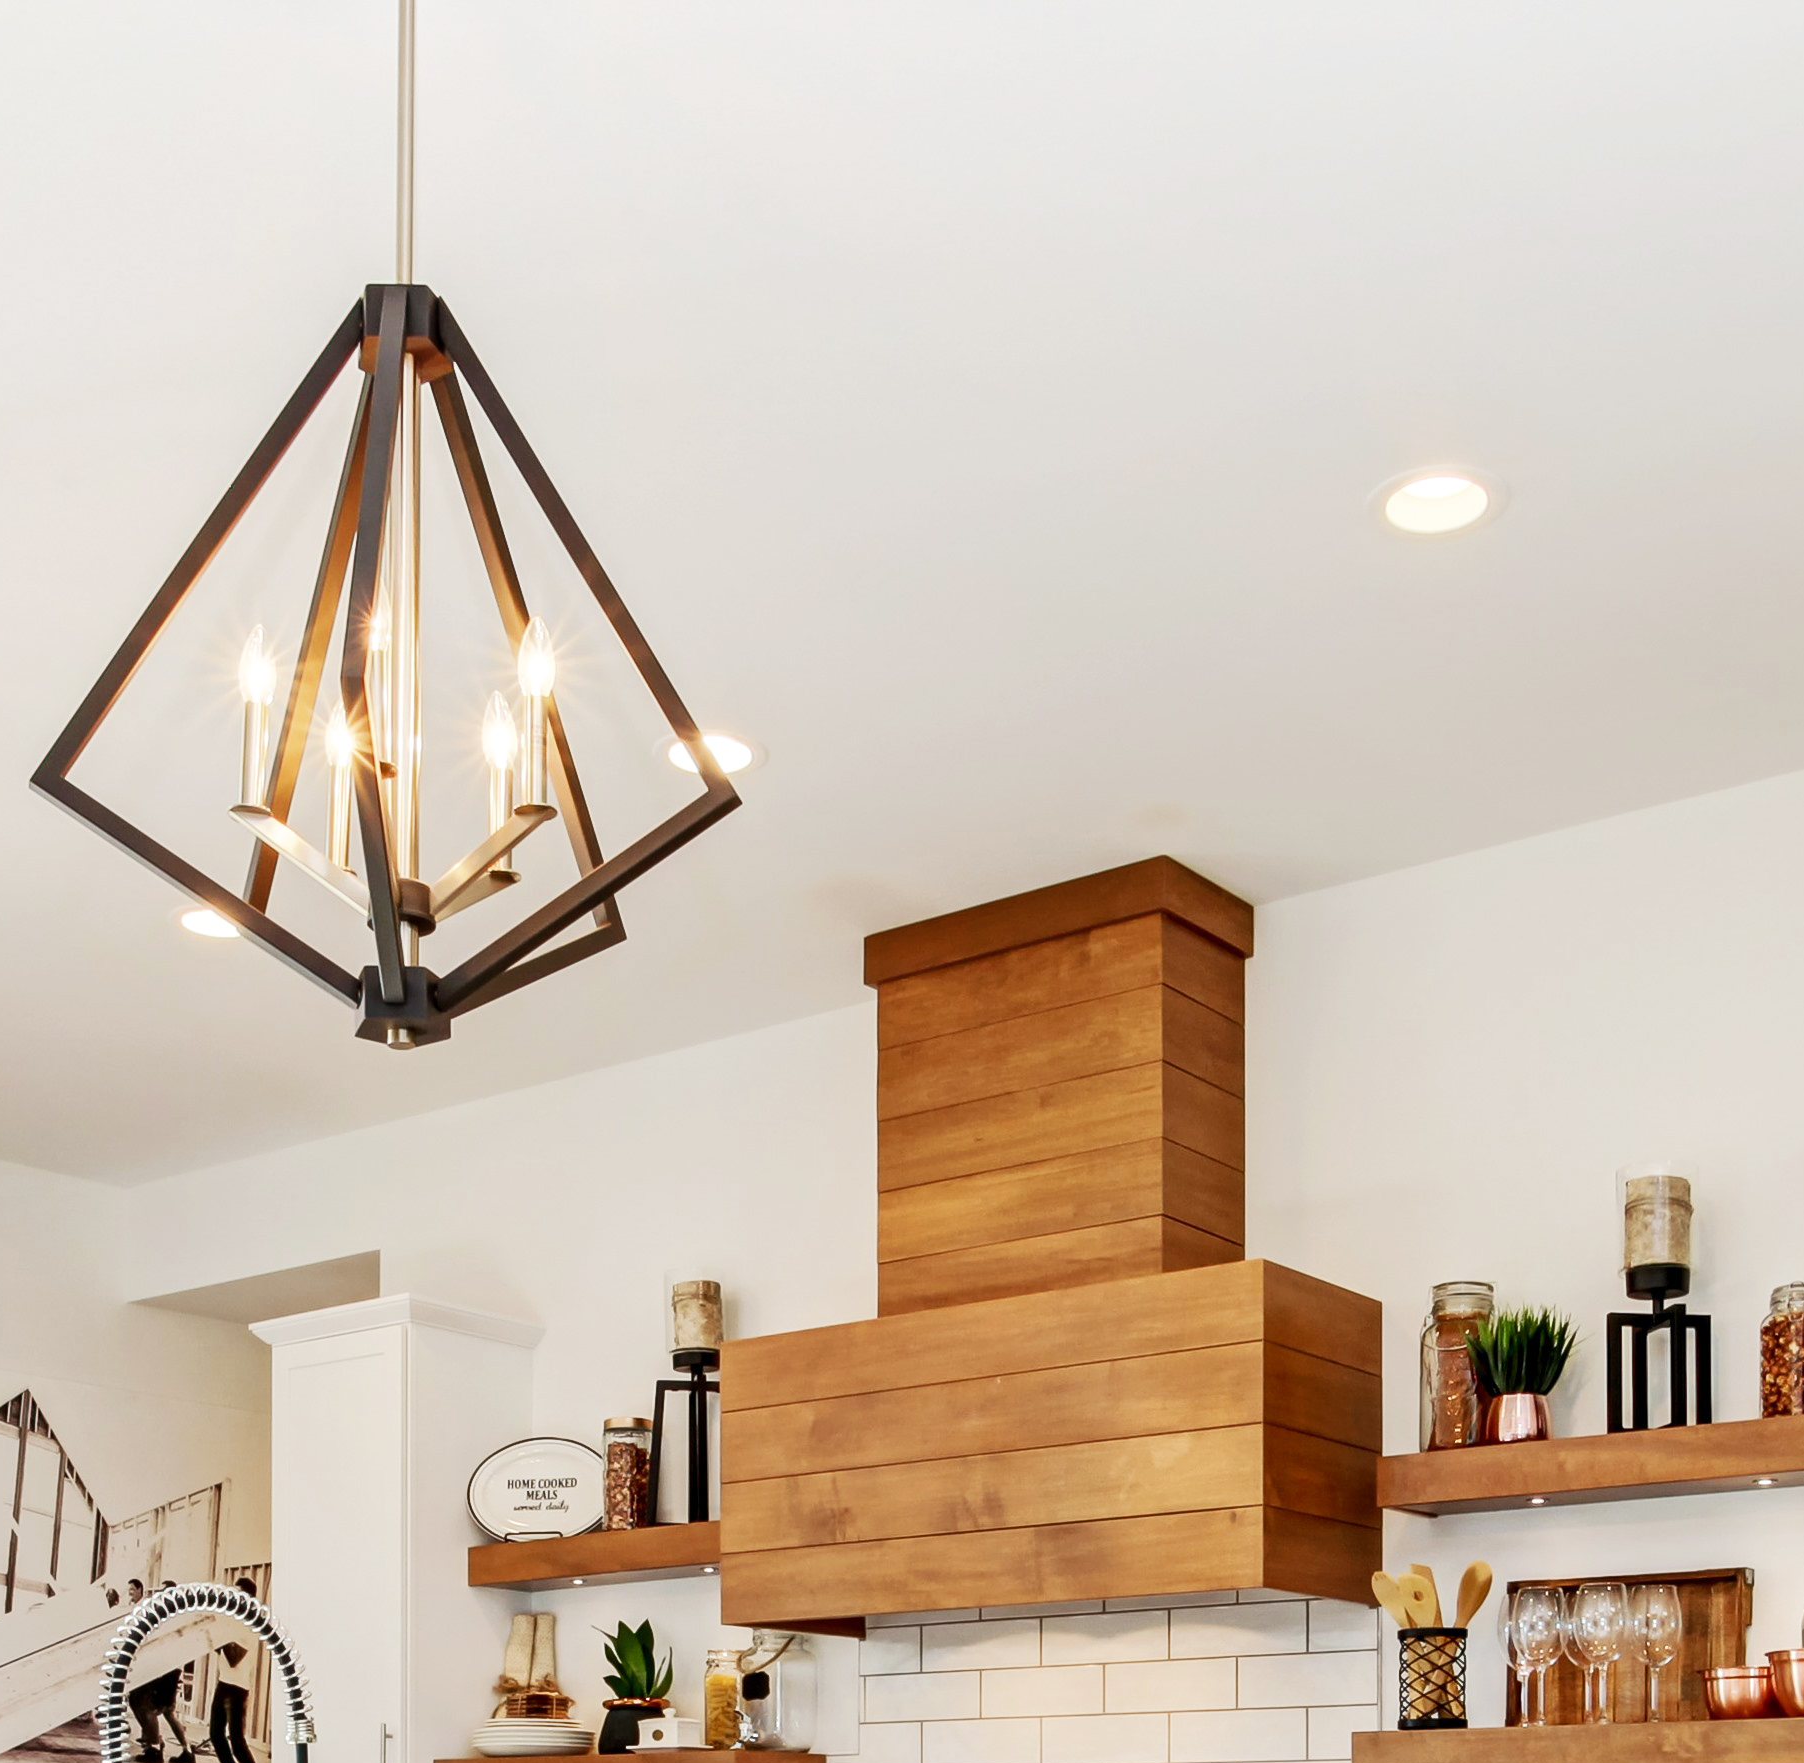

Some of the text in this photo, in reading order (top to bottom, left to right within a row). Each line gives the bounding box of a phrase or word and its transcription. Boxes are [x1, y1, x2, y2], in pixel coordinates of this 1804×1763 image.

[507, 1477, 578, 1489] HOME COOKED
[526, 1489, 558, 1500] MEALS
[546, 1500, 569, 1513] daily
